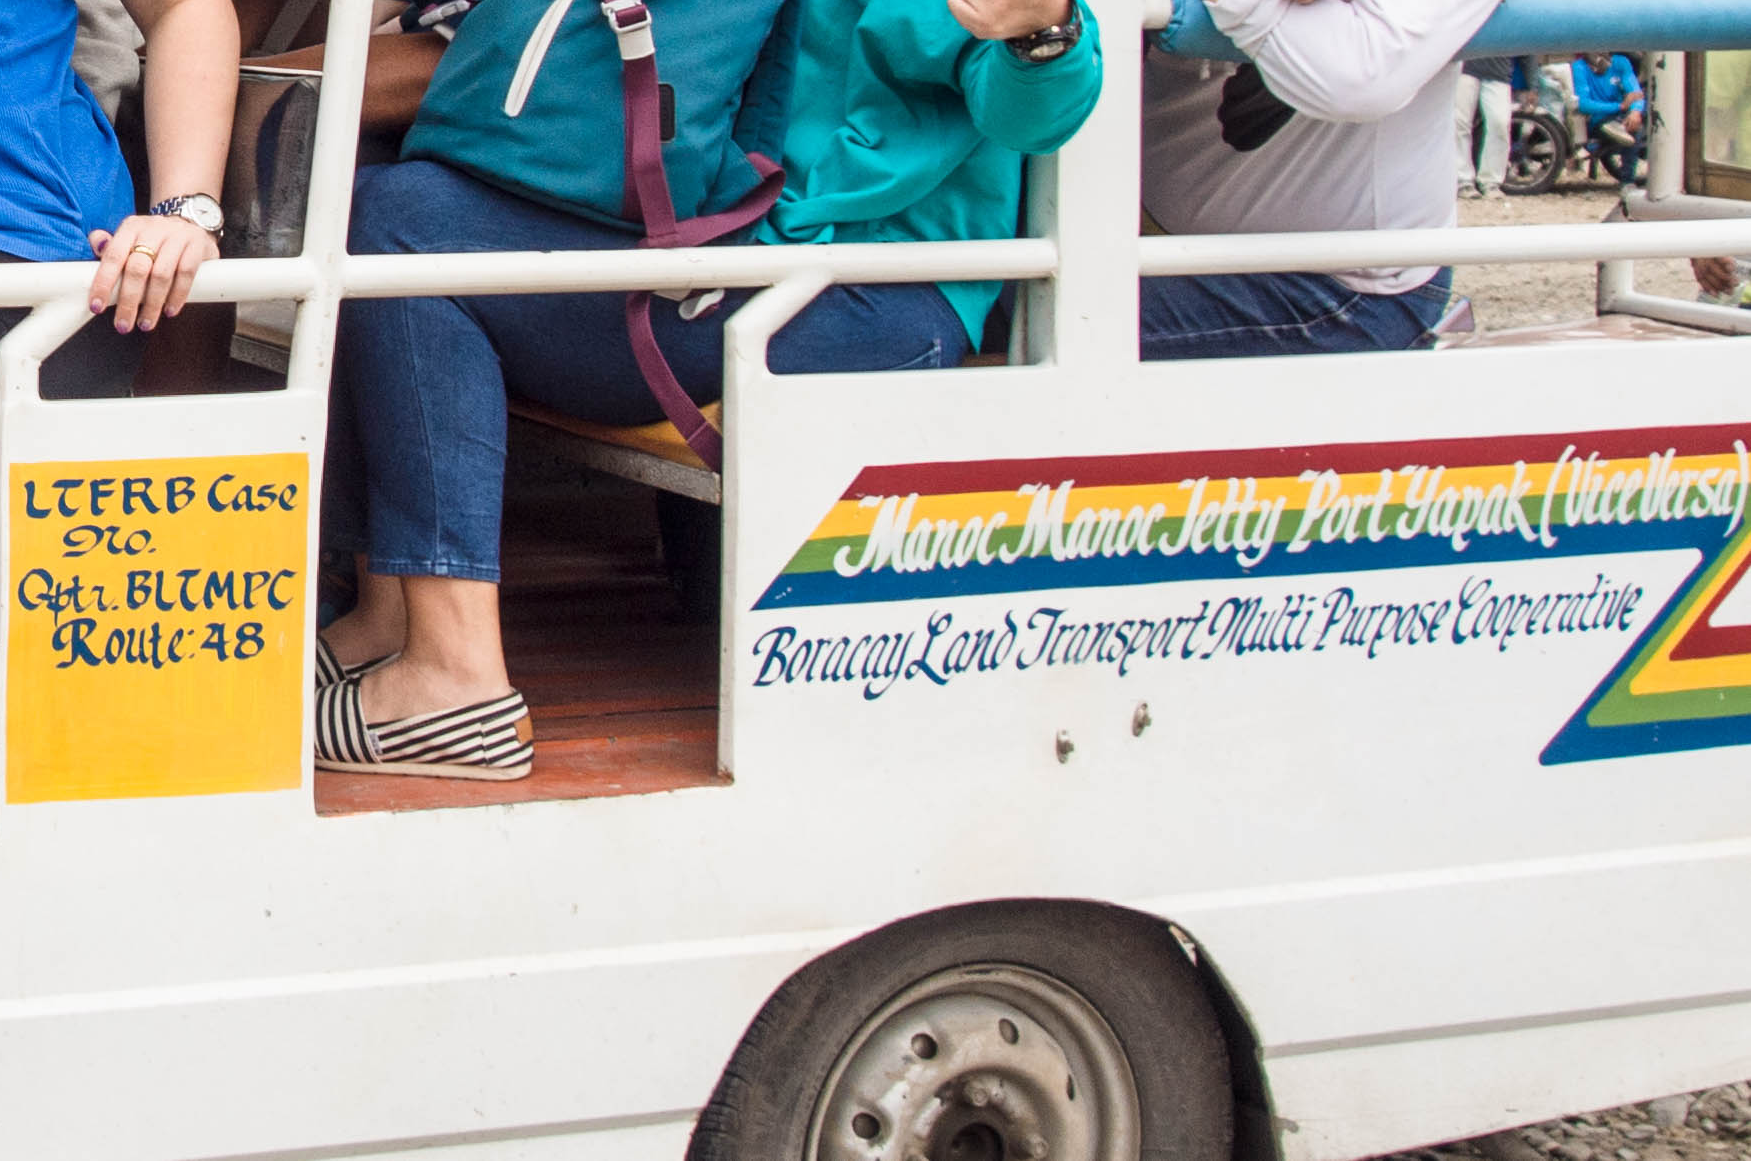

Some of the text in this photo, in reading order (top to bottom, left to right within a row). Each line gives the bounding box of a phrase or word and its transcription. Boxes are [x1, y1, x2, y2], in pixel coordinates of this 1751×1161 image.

[23, 473, 299, 519] LTFRB Case
[833, 492, 1008, 577] Manoc
[999, 479, 1166, 563] Manoc
[1159, 476, 1287, 567] Jetty
[1286, 468, 1393, 553] Port
[1395, 460, 1538, 552] Yapak
[125, 567, 299, 613] BLTMPC
[200, 622, 266, 662] 48
[752, 574, 1643, 700] Boracay Land Transport Multi Purpose Cooperative
